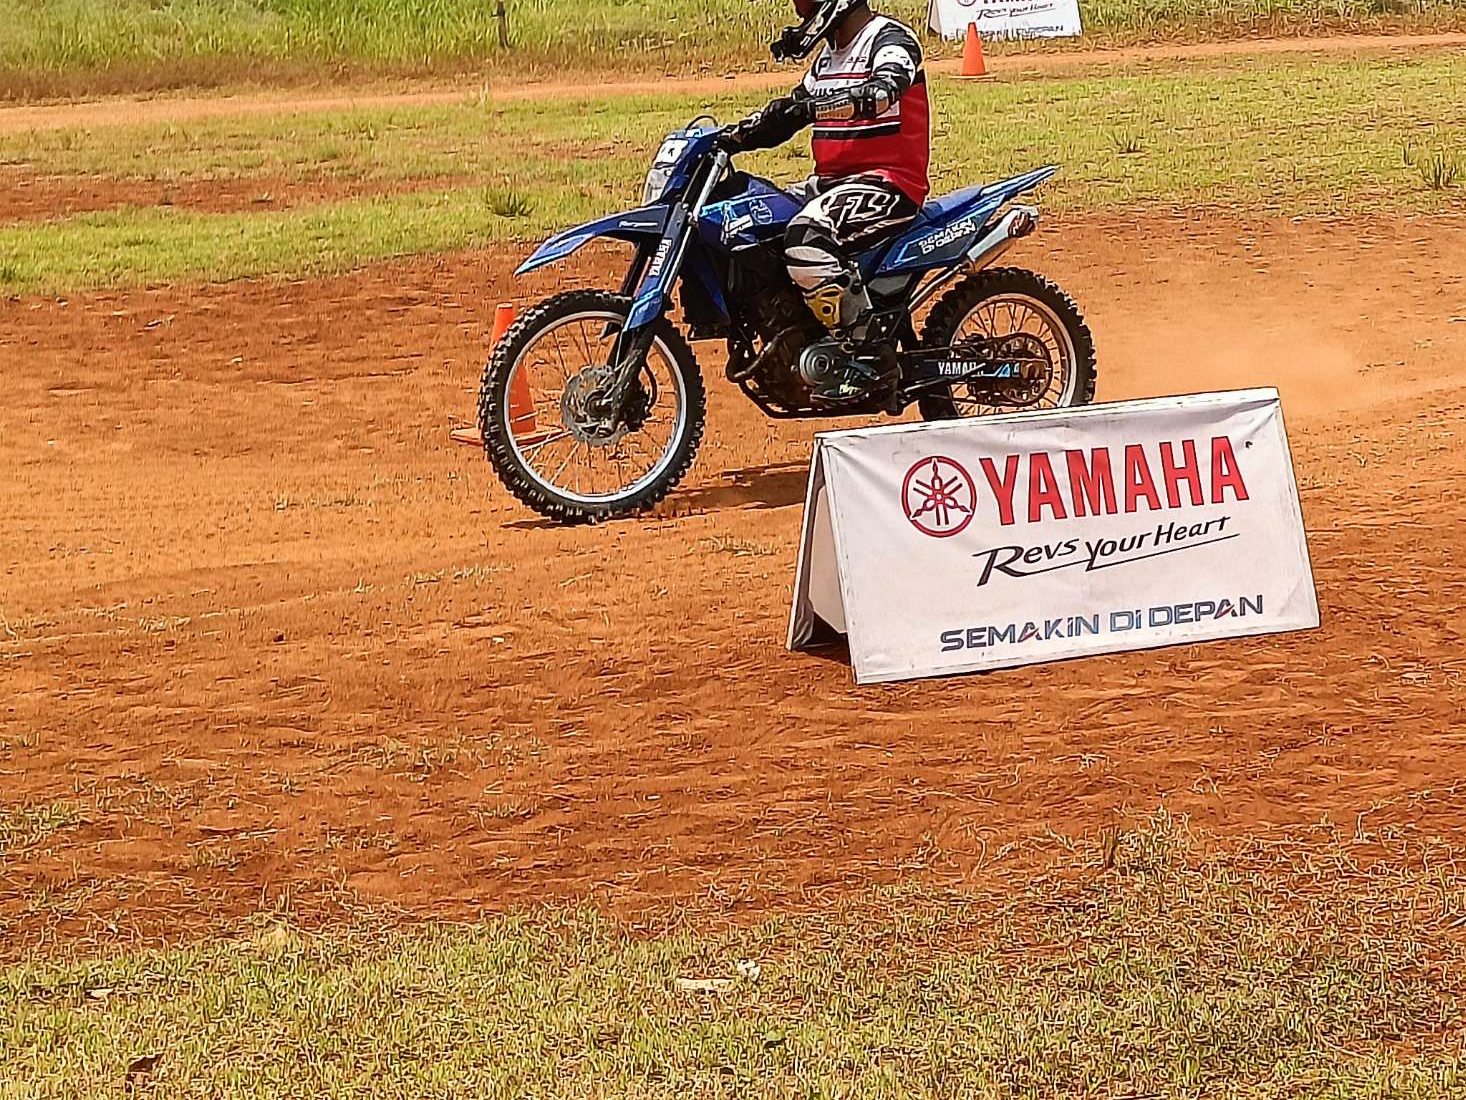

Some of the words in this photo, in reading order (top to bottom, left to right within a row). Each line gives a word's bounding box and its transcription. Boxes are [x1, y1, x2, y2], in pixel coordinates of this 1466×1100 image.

[978, 435, 1250, 526] YAMAHA
[972, 537, 1081, 588] Revs
[1084, 531, 1153, 572] your
[1154, 516, 1232, 548] Heart
[1149, 594, 1264, 628] DEPAN
